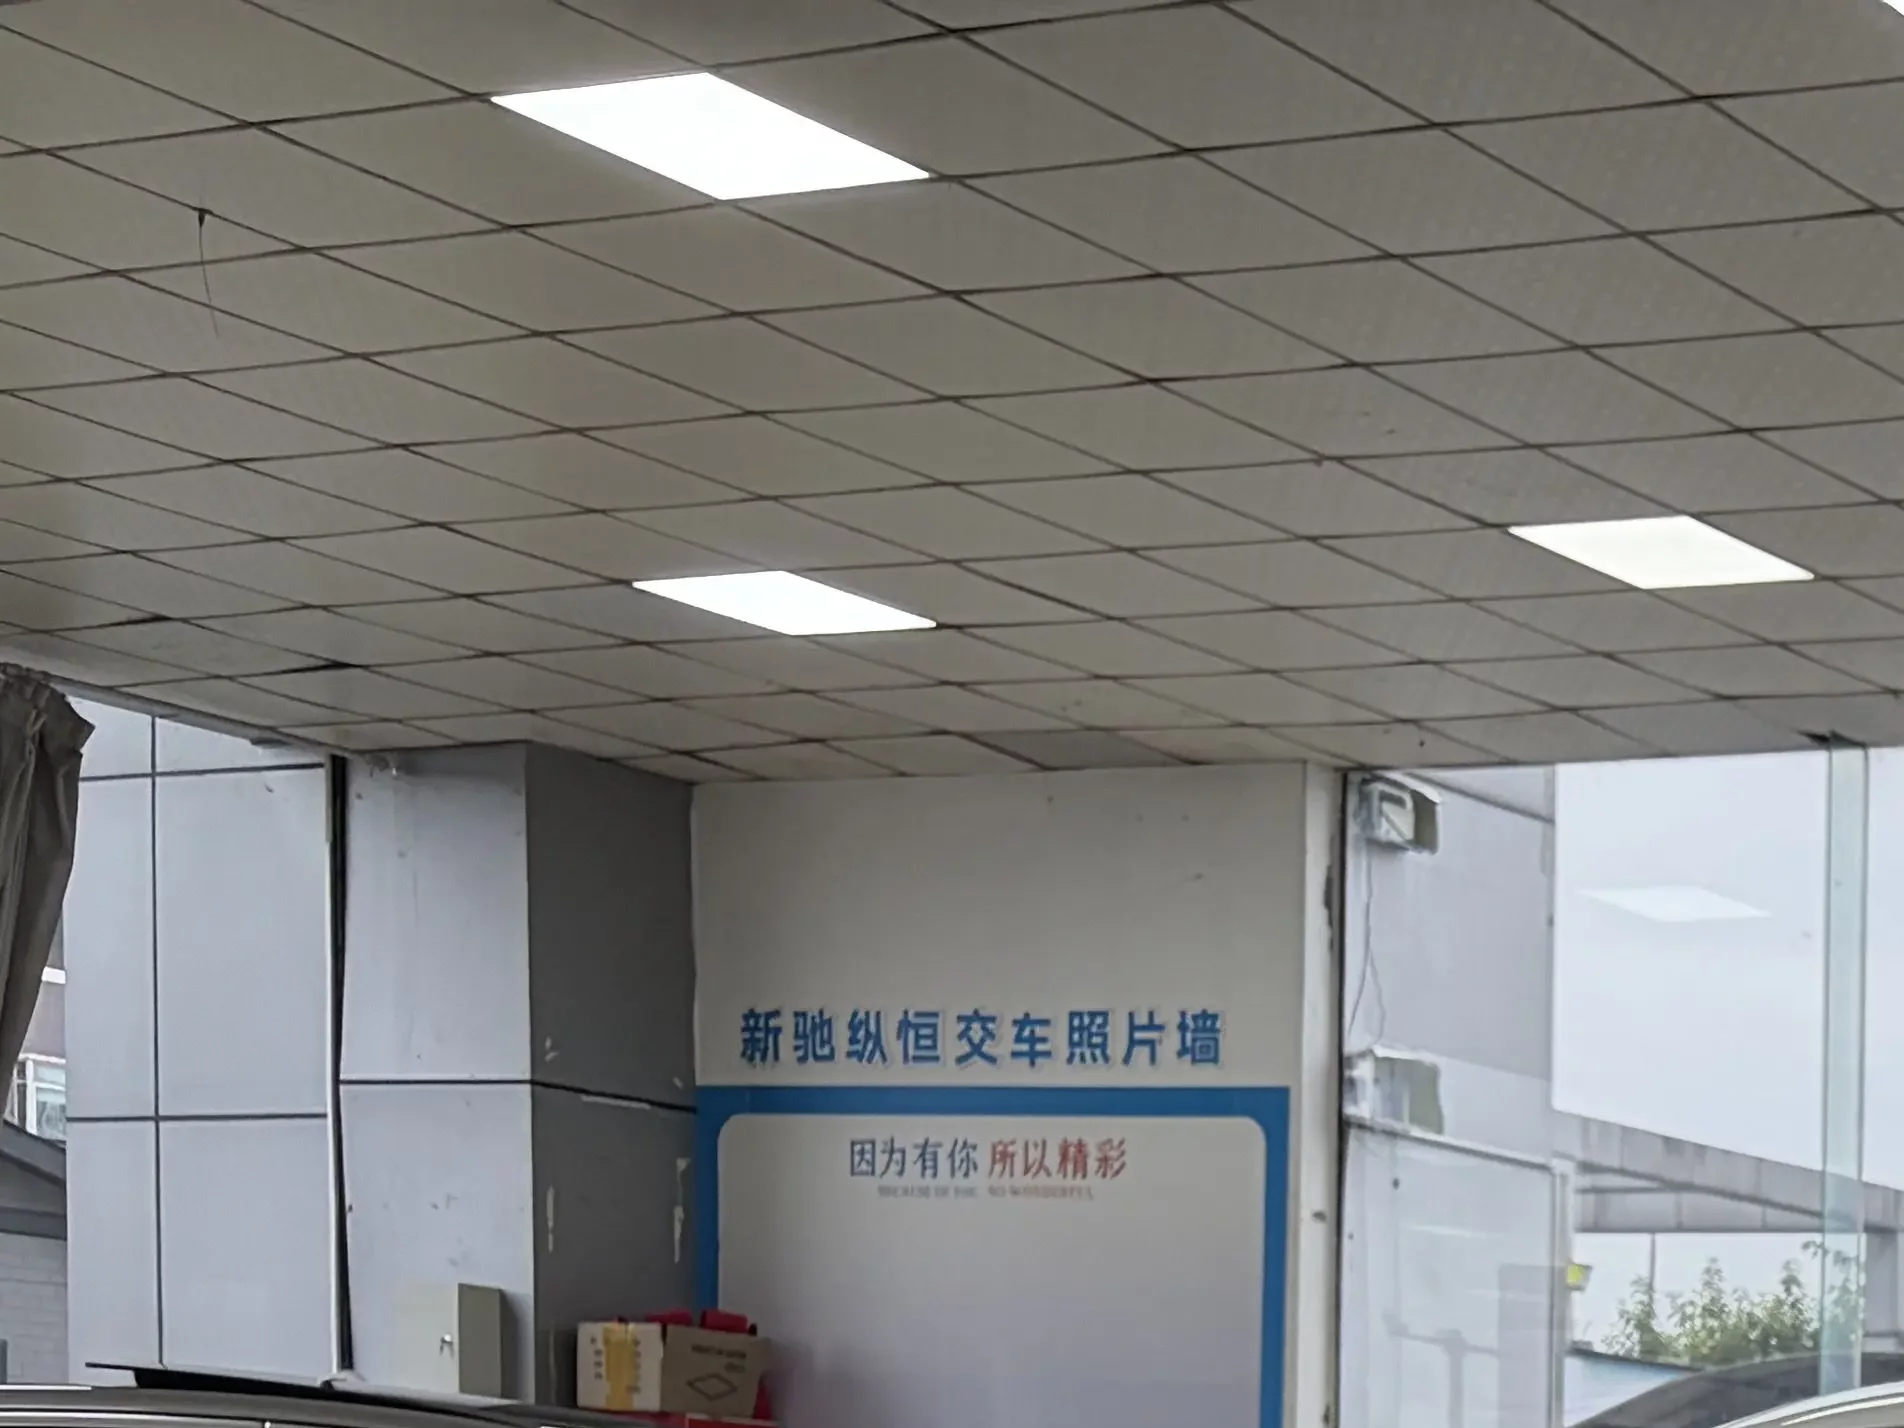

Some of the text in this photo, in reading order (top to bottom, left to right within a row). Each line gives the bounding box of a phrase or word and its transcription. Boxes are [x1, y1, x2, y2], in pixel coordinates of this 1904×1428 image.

[740, 1009, 1224, 1068] 新驰纵恒交车照片墙
[849, 1136, 1127, 1180] 因为有你 所以精彩
